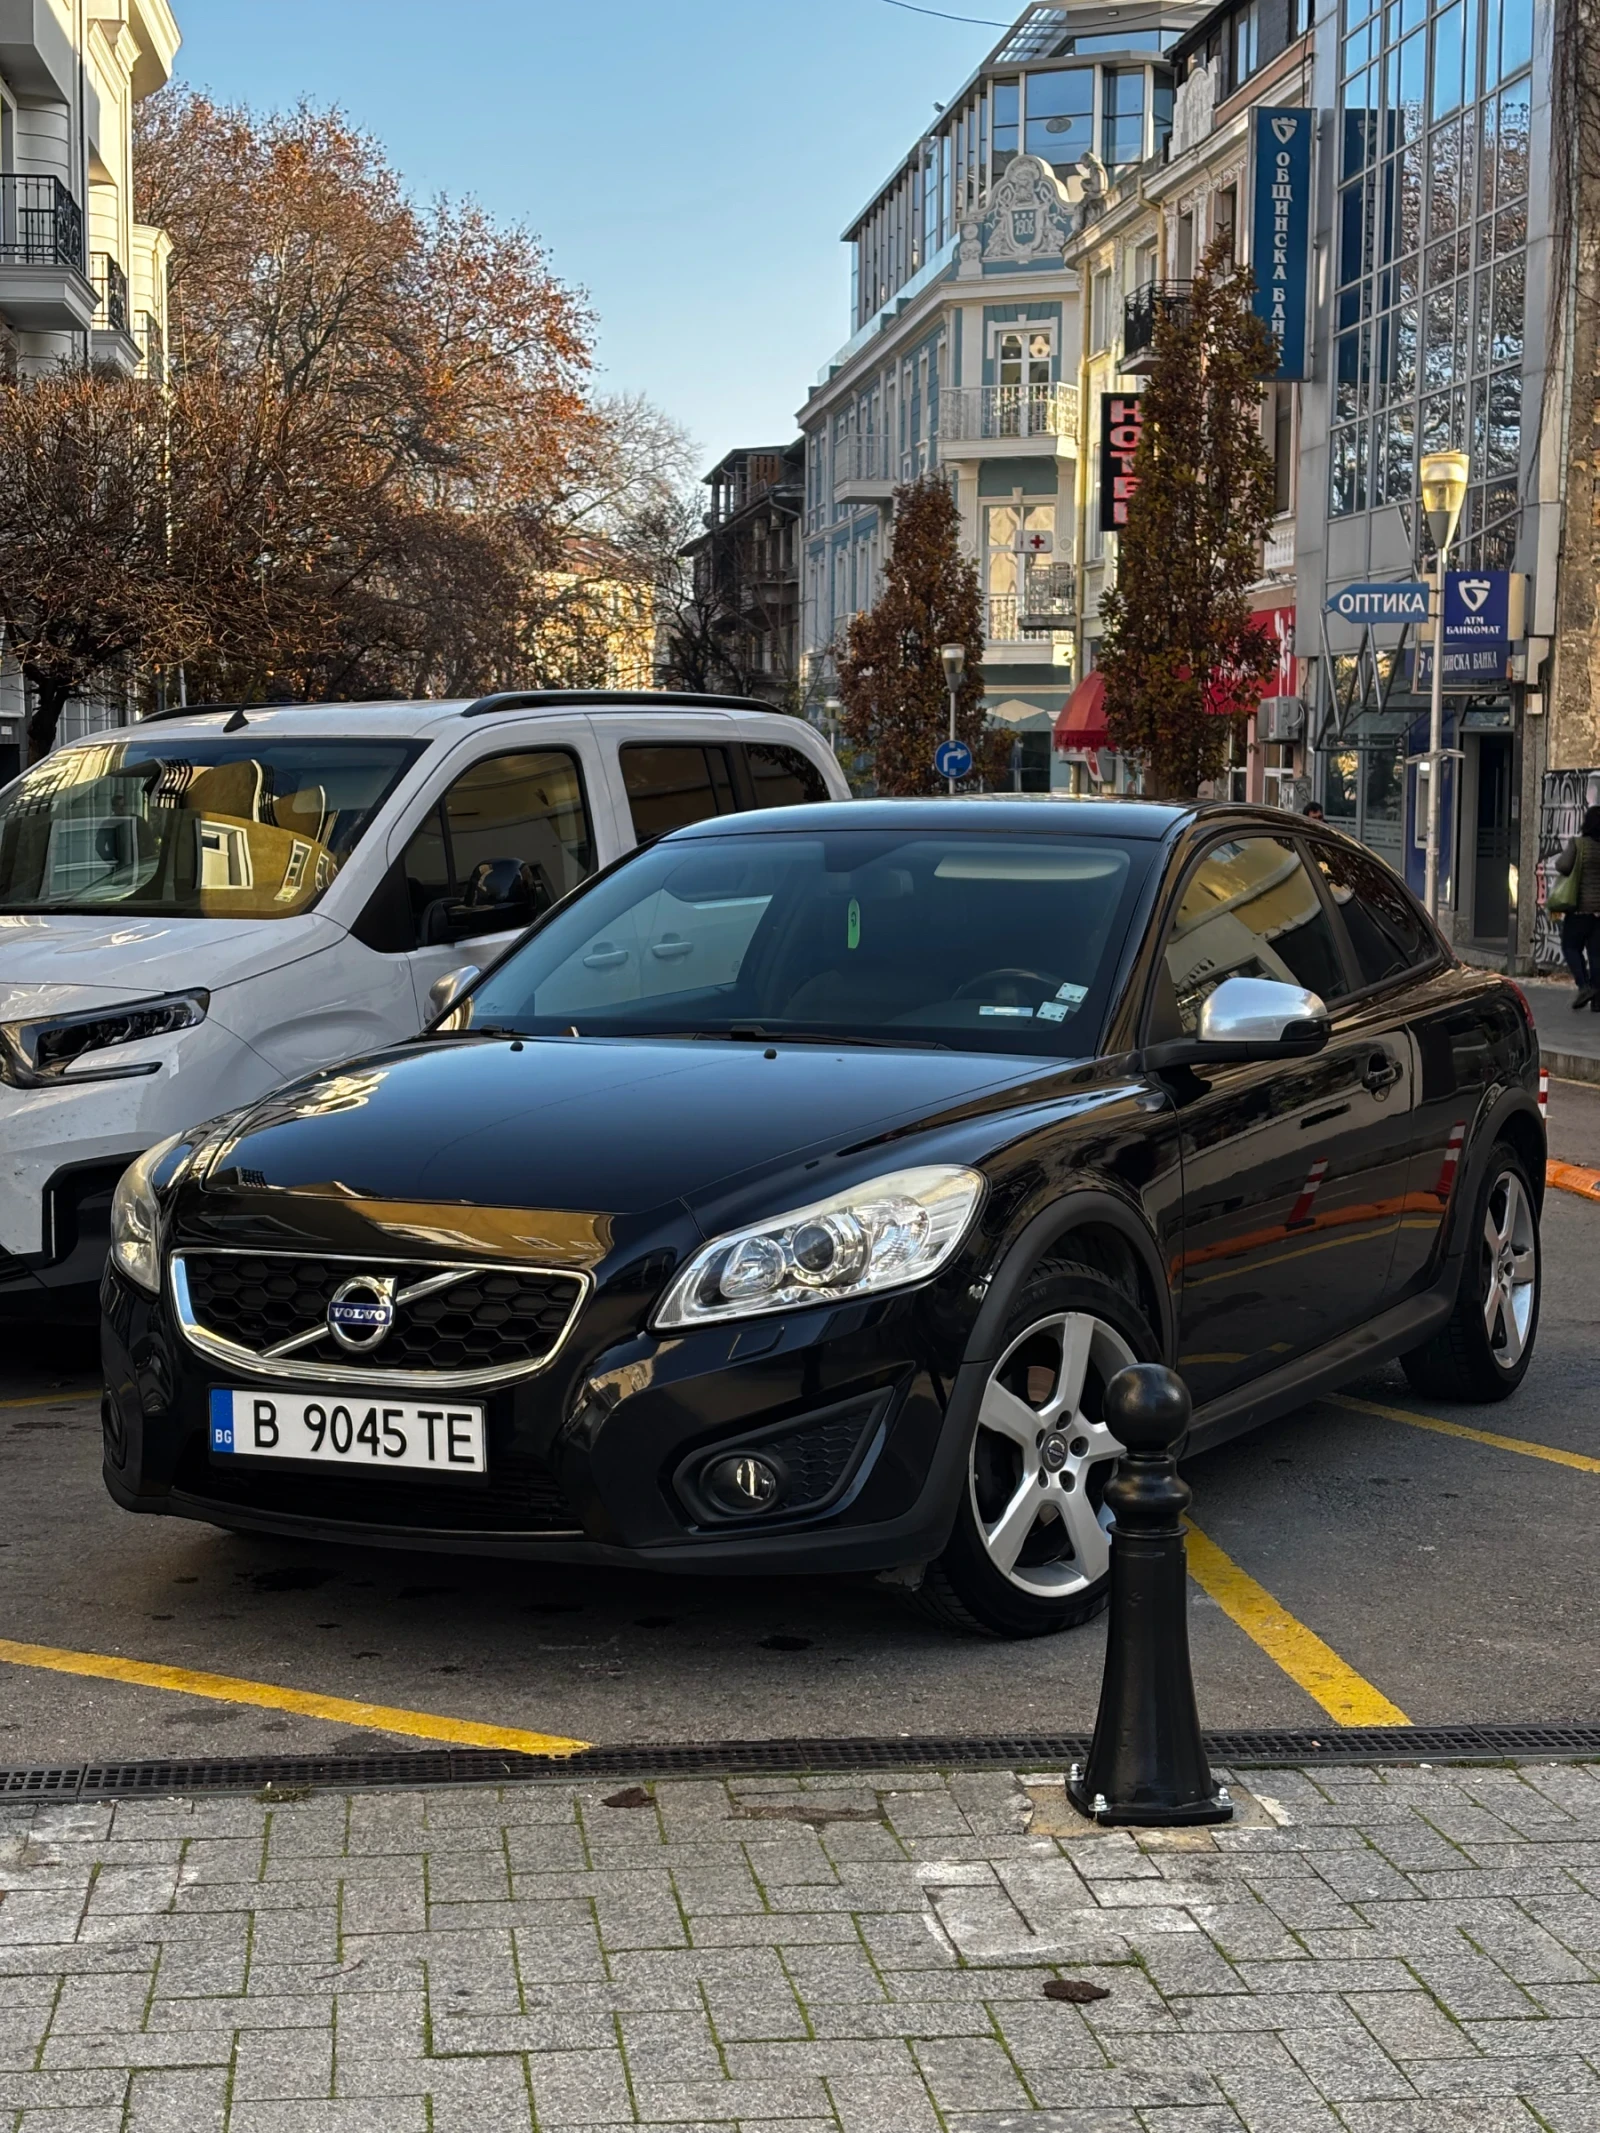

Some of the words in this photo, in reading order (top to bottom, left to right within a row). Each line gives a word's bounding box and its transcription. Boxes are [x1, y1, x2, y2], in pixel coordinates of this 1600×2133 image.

[1271, 151, 1293, 280] ОБЩИНСКА
[1338, 592, 1425, 614] ОПТИКА
[1446, 625, 1501, 635] БАНКОМАТ
[1463, 616, 1484, 625] АТМ
[1427, 653, 1470, 673] ОИНСКА
[1473, 651, 1498, 670] БАНКА
[331, 1306, 386, 1322] VOLVO
[215, 1428, 232, 1444] BG
[253, 1399, 280, 1449] B
[303, 1403, 408, 1459] 9045
[417, 1410, 475, 1464] TE
